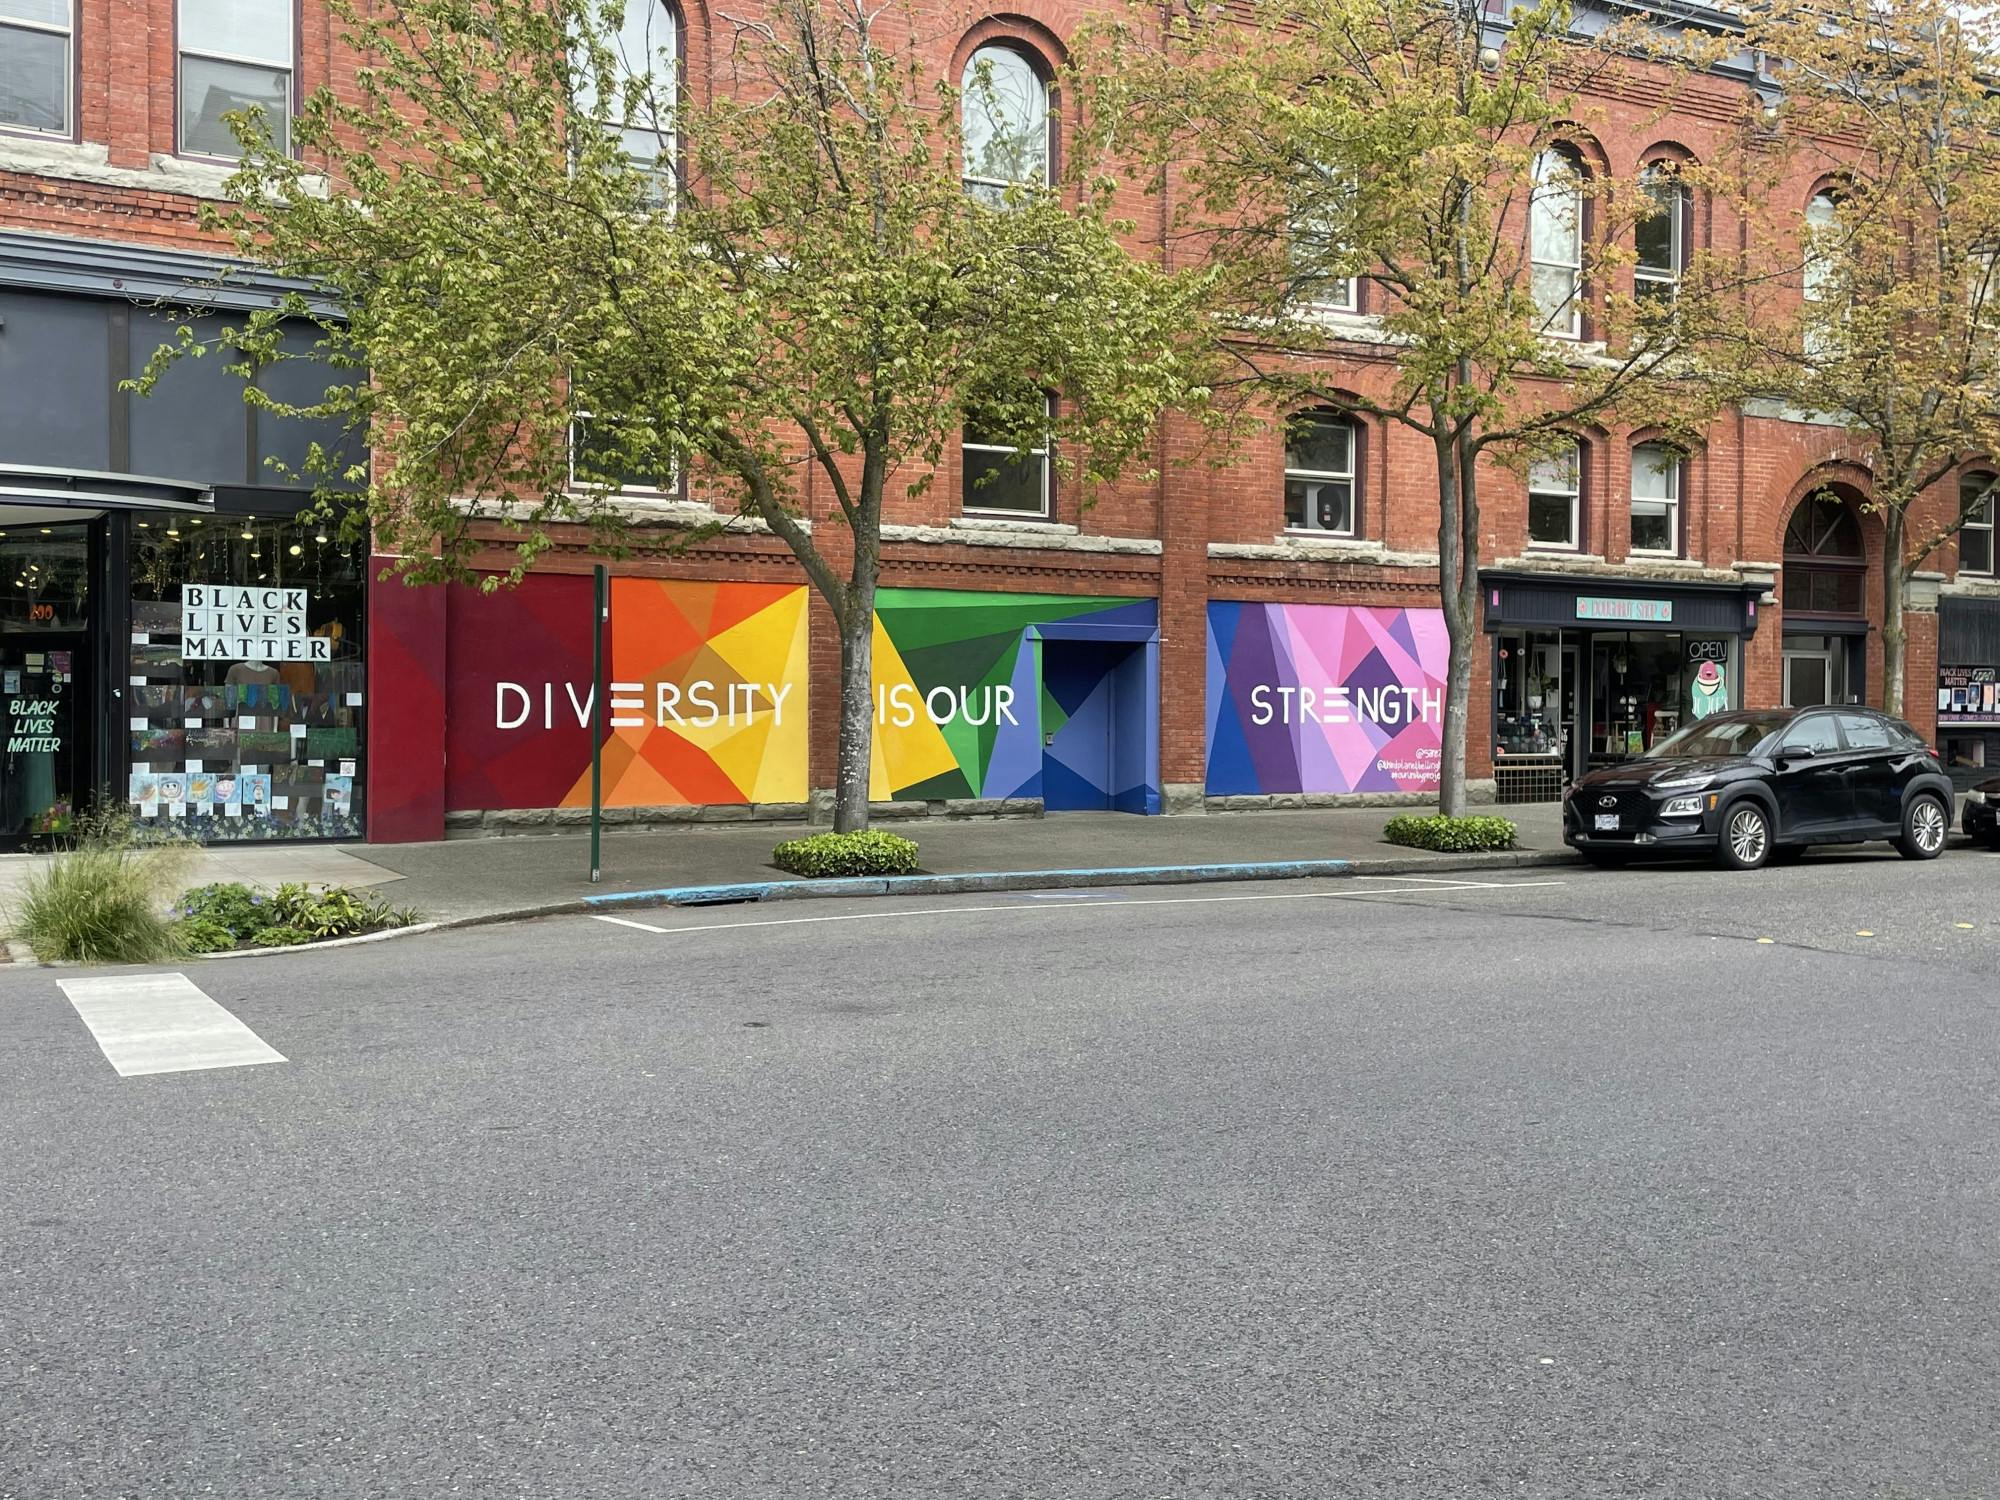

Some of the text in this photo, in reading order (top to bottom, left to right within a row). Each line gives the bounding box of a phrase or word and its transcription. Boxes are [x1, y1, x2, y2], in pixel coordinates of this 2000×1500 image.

[187, 587, 303, 611] BLACK
[187, 611, 302, 636] LIVES
[185, 636, 328, 659] MATTER
[1689, 641, 1727, 658] OPEN
[1944, 677, 1968, 686] MATTER
[9, 700, 60, 716] BLACK
[496, 680, 1441, 730] DIVERSITY IS OUR STRENGTH
[14, 718, 55, 734] LIVES
[7, 737, 61, 753] MATTER
